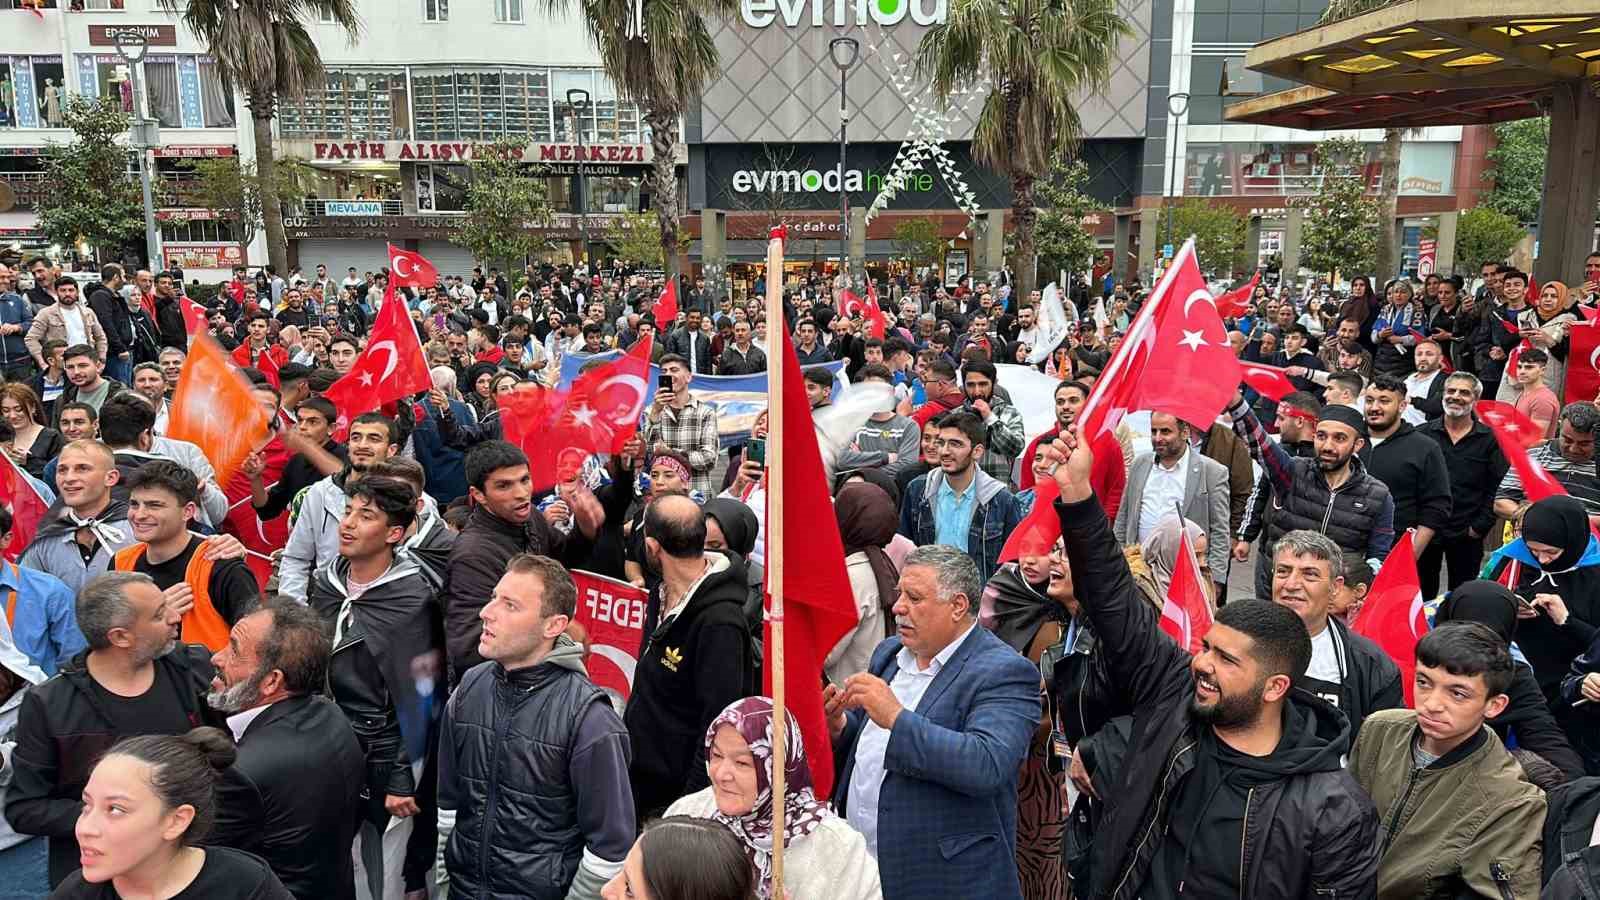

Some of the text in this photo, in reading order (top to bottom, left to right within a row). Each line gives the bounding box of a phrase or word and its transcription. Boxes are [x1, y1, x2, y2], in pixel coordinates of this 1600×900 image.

[741, 0, 946, 28] evmod
[315, 141, 385, 159] FATİH
[551, 165, 574, 175] AİLE
[732, 163, 933, 193] evmoda hme
[328, 203, 380, 214] MEVLANA
